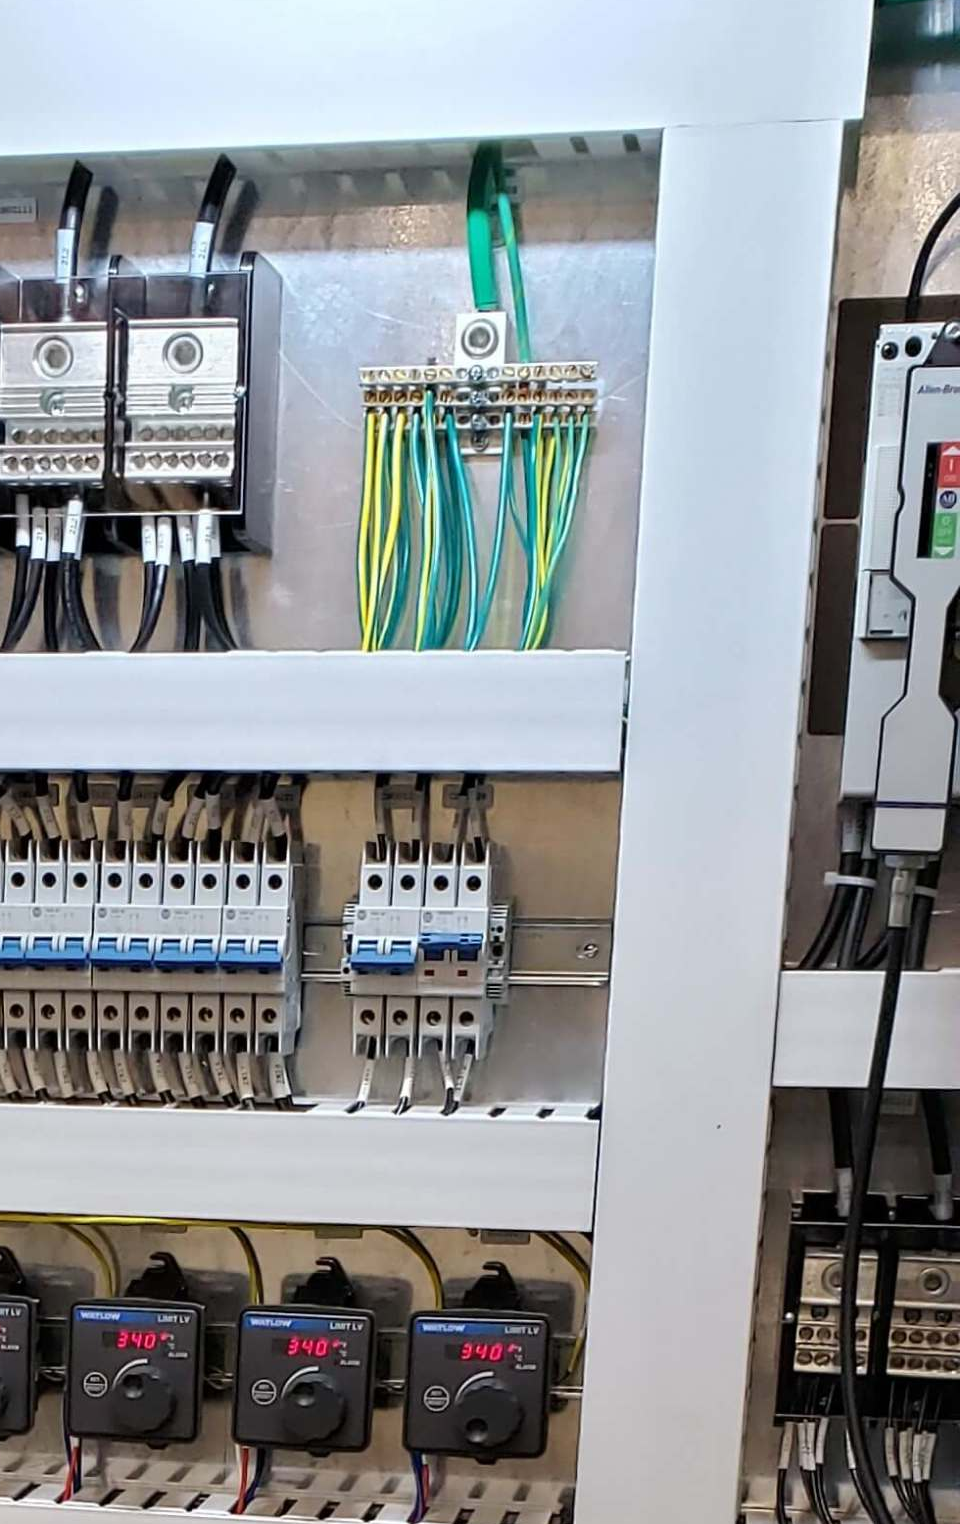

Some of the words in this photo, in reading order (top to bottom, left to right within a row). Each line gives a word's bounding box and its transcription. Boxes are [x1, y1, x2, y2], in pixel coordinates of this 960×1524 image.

[80, 1311, 121, 1321] WATLOW
[250, 1318, 292, 1328] WATLOW
[422, 1323, 466, 1332] WATLOW
[116, 1330, 157, 1351] 340
[286, 1337, 328, 1358] 340
[460, 1342, 504, 1362] 340
